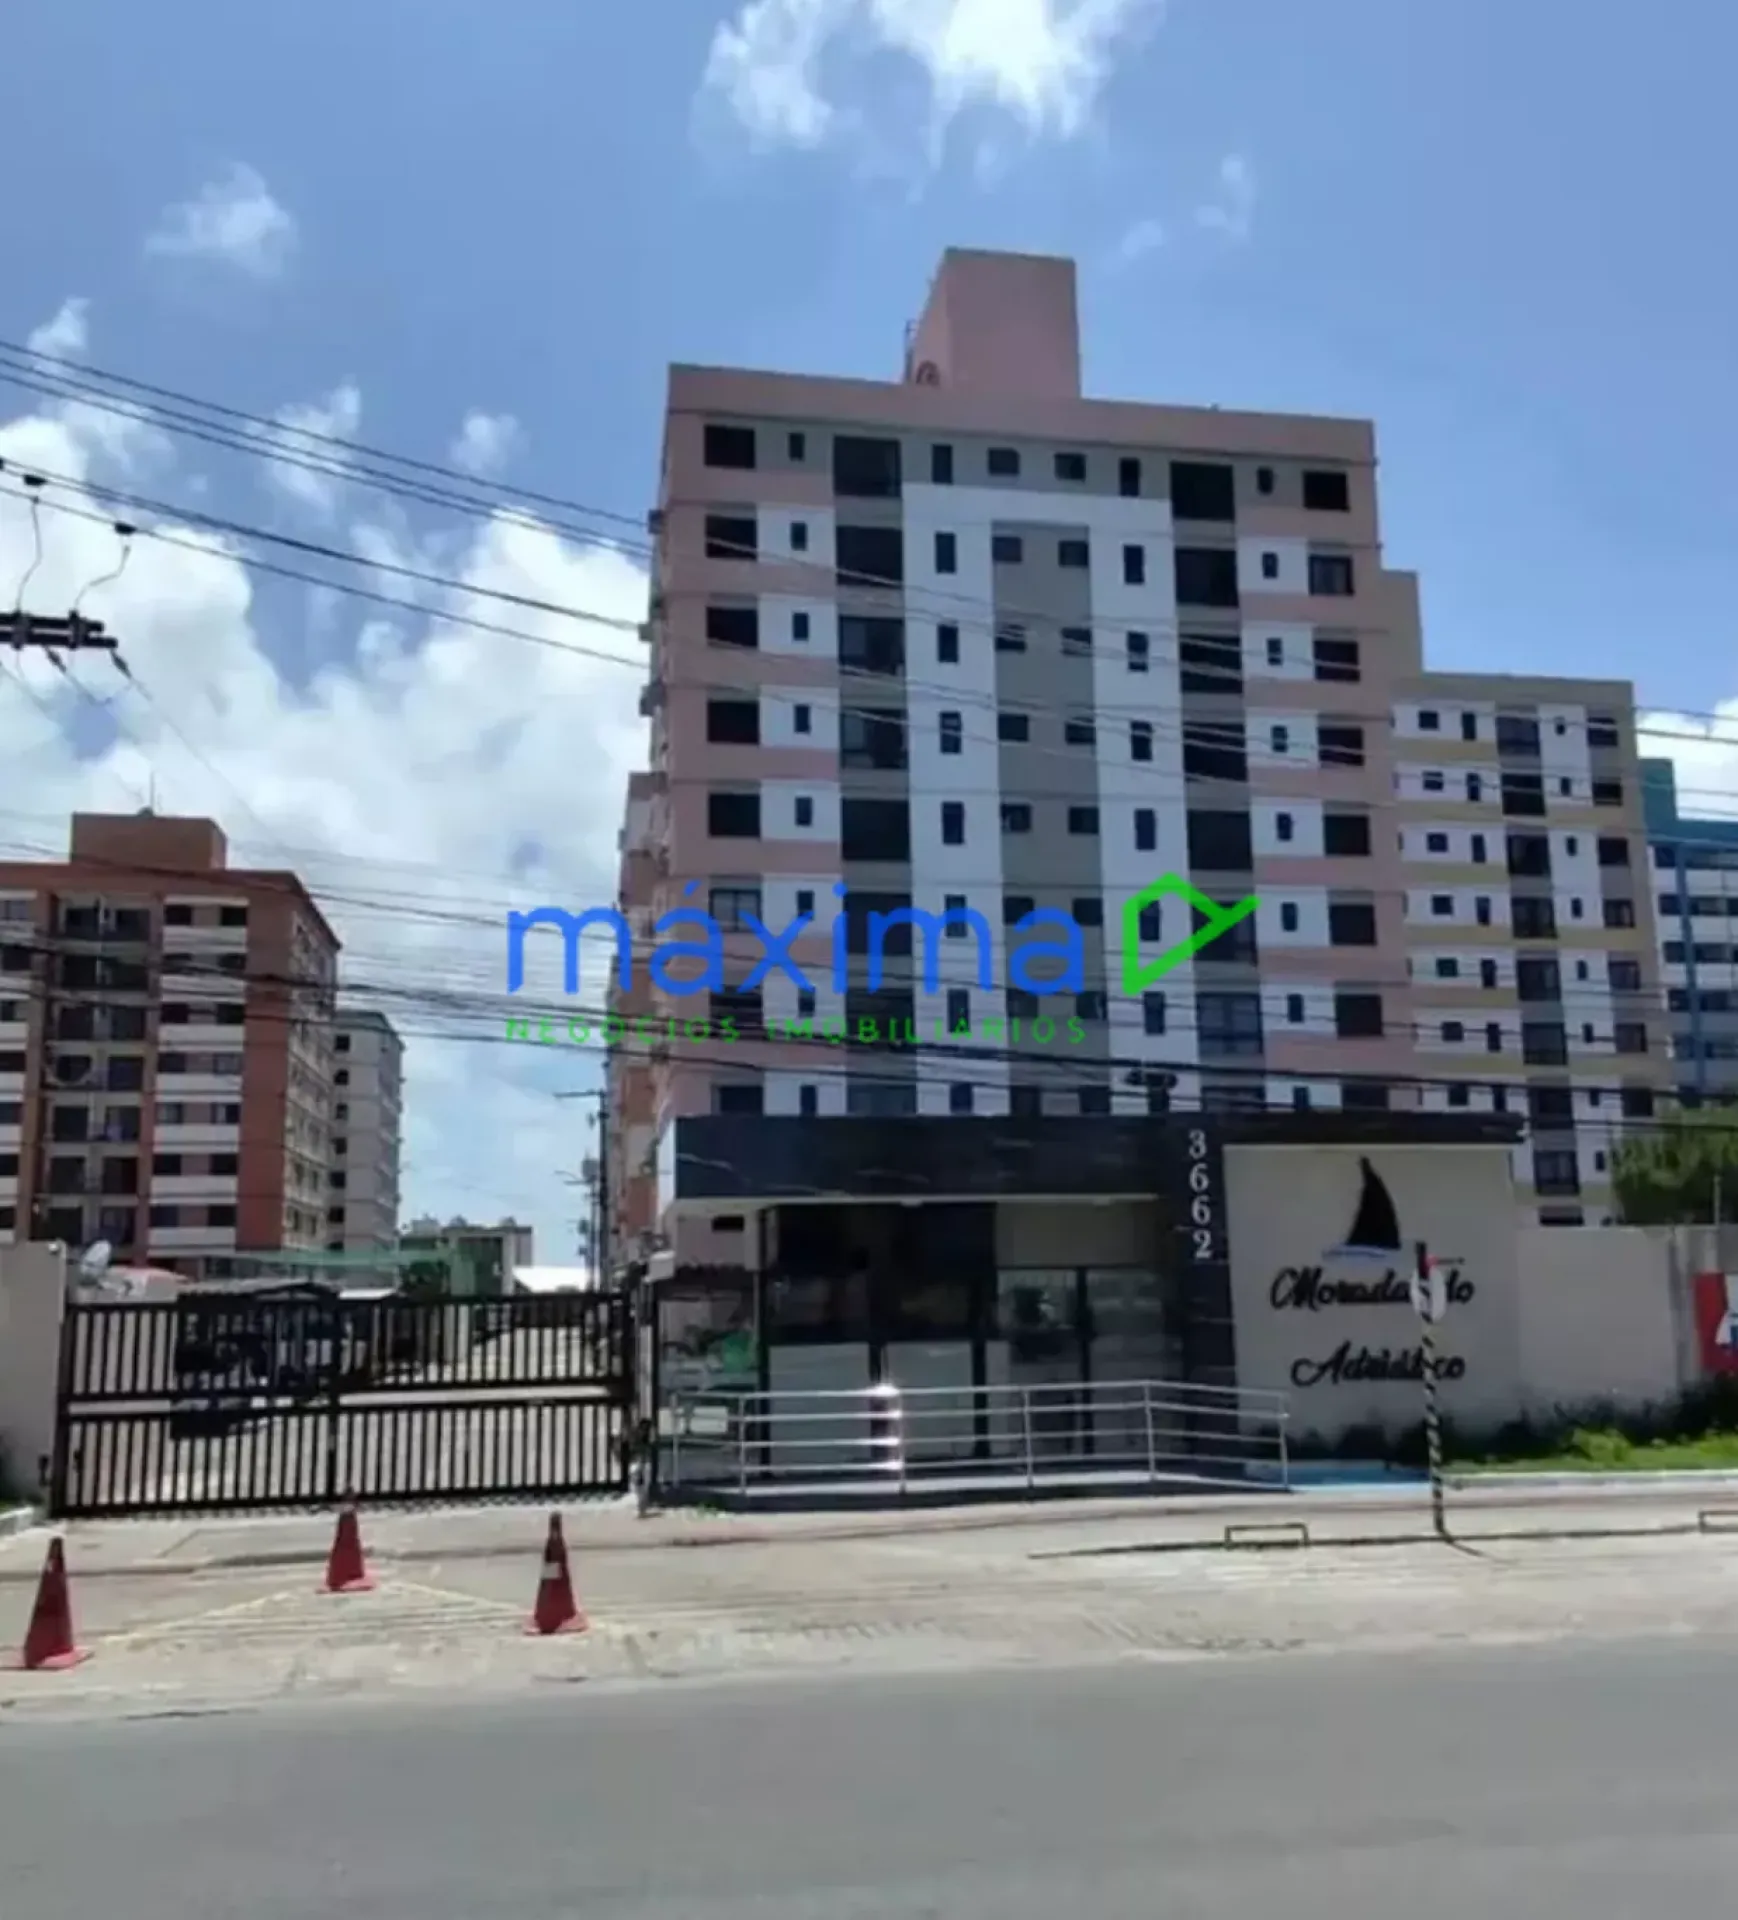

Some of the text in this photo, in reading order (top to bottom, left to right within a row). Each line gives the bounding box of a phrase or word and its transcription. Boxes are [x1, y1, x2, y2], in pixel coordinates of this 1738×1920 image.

[1188, 1129, 1213, 1258] 3662
[1271, 1266, 1412, 1312] Morada
[1291, 1340, 1466, 1387] Adriátco
